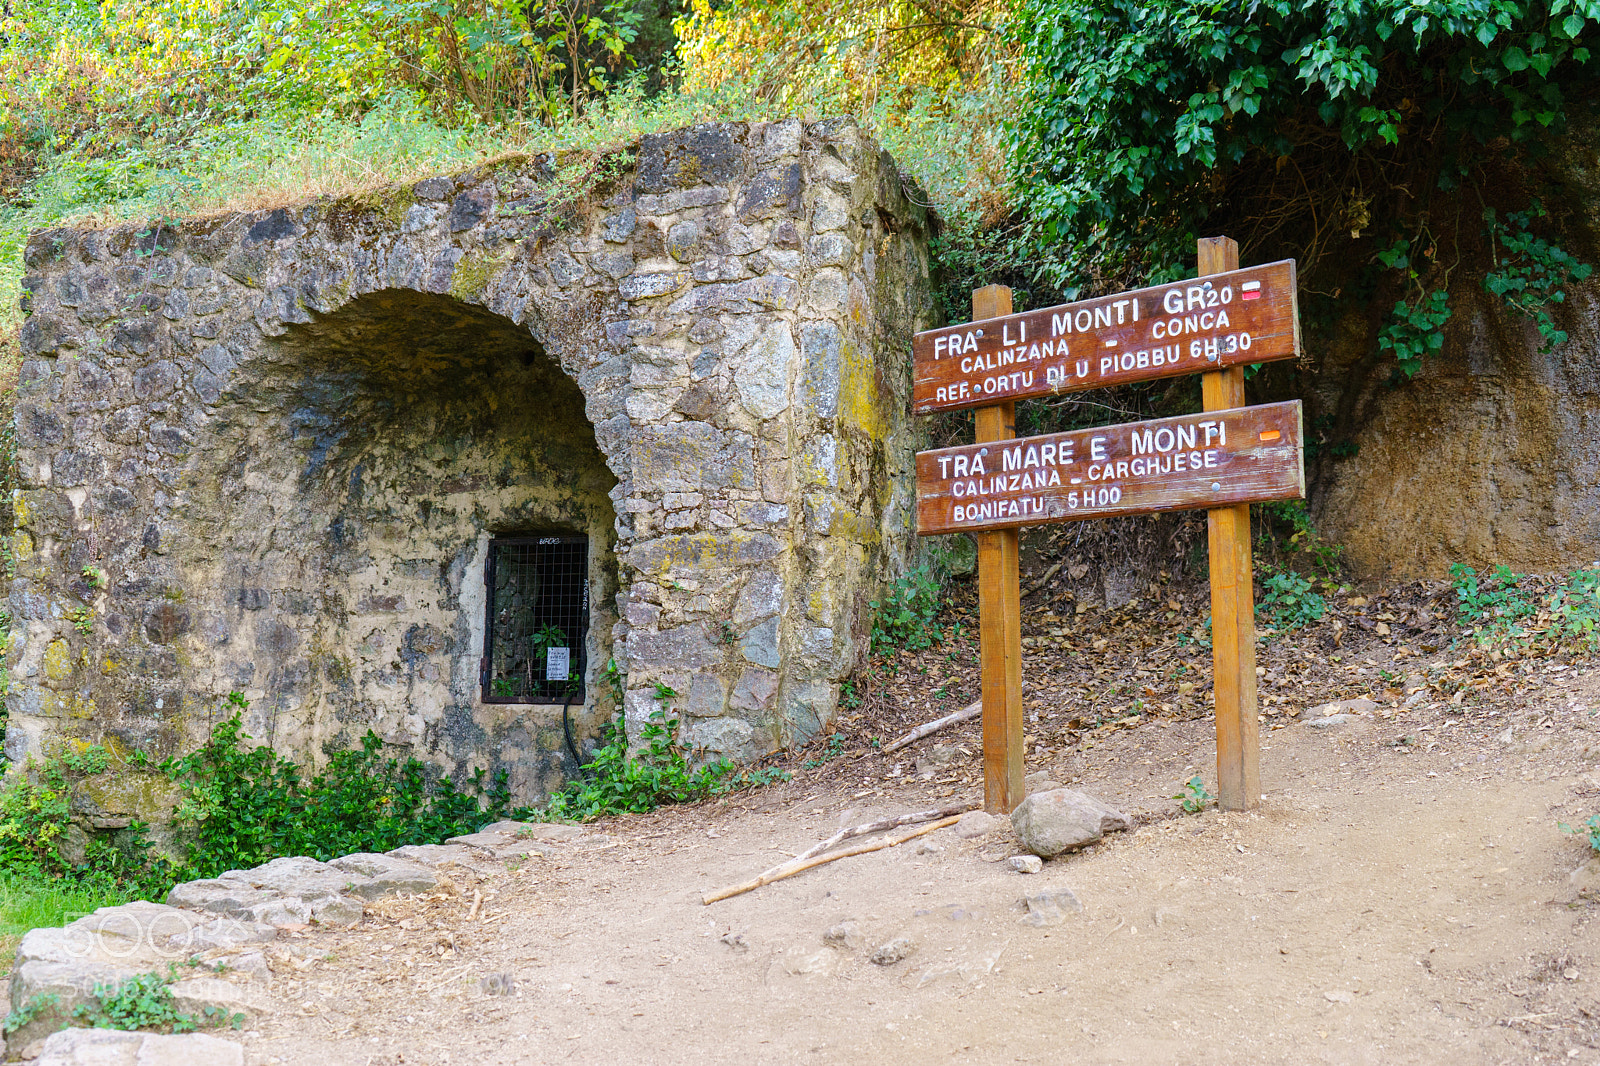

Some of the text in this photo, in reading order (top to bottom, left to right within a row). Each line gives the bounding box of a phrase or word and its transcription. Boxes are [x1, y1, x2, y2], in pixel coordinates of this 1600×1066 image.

[934, 331, 978, 360] FRA
[1003, 320, 1026, 347] LI
[1052, 298, 1139, 337] MONTI
[961, 338, 1069, 374] CALINZANA
[1152, 309, 1230, 339] CONCA
[936, 380, 970, 402] REF.
[983, 370, 1033, 394] ORTU
[1046, 364, 1065, 384] DI
[1075, 360, 1089, 378] U
[1100, 343, 1180, 376] PIOBBU
[937, 420, 1227, 480] TRA MARE E MONTI
[952, 469, 1061, 497] CALINZANA
[1087, 450, 1218, 481] CARGHJESE
[953, 496, 1044, 522] BONIFATU
